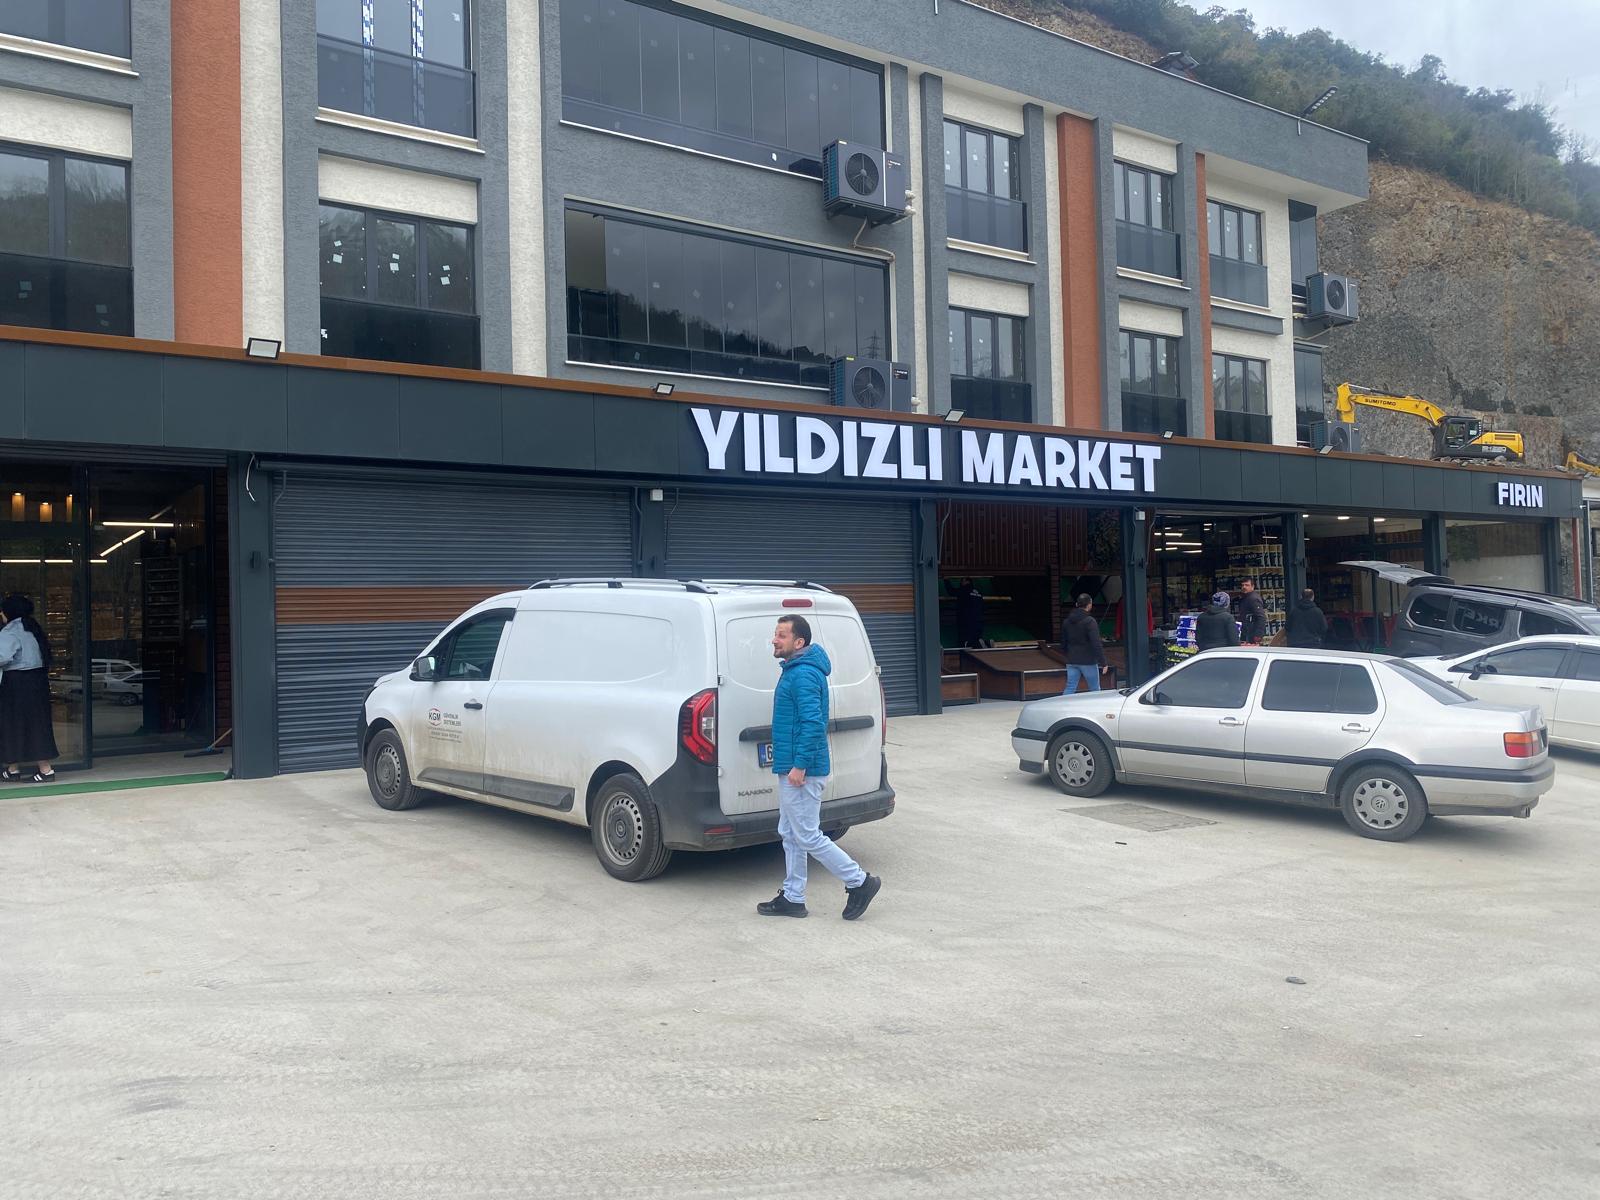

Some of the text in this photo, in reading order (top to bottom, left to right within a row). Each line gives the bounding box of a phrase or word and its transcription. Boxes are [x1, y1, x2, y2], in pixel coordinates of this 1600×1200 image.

[1365, 398, 1397, 407] SUMITOMO
[690, 407, 1162, 493] YILDIZLI MARKET
[1498, 481, 1543, 508] FIRIN
[428, 712, 441, 721] KGM
[738, 788, 773, 797] KANGOO
